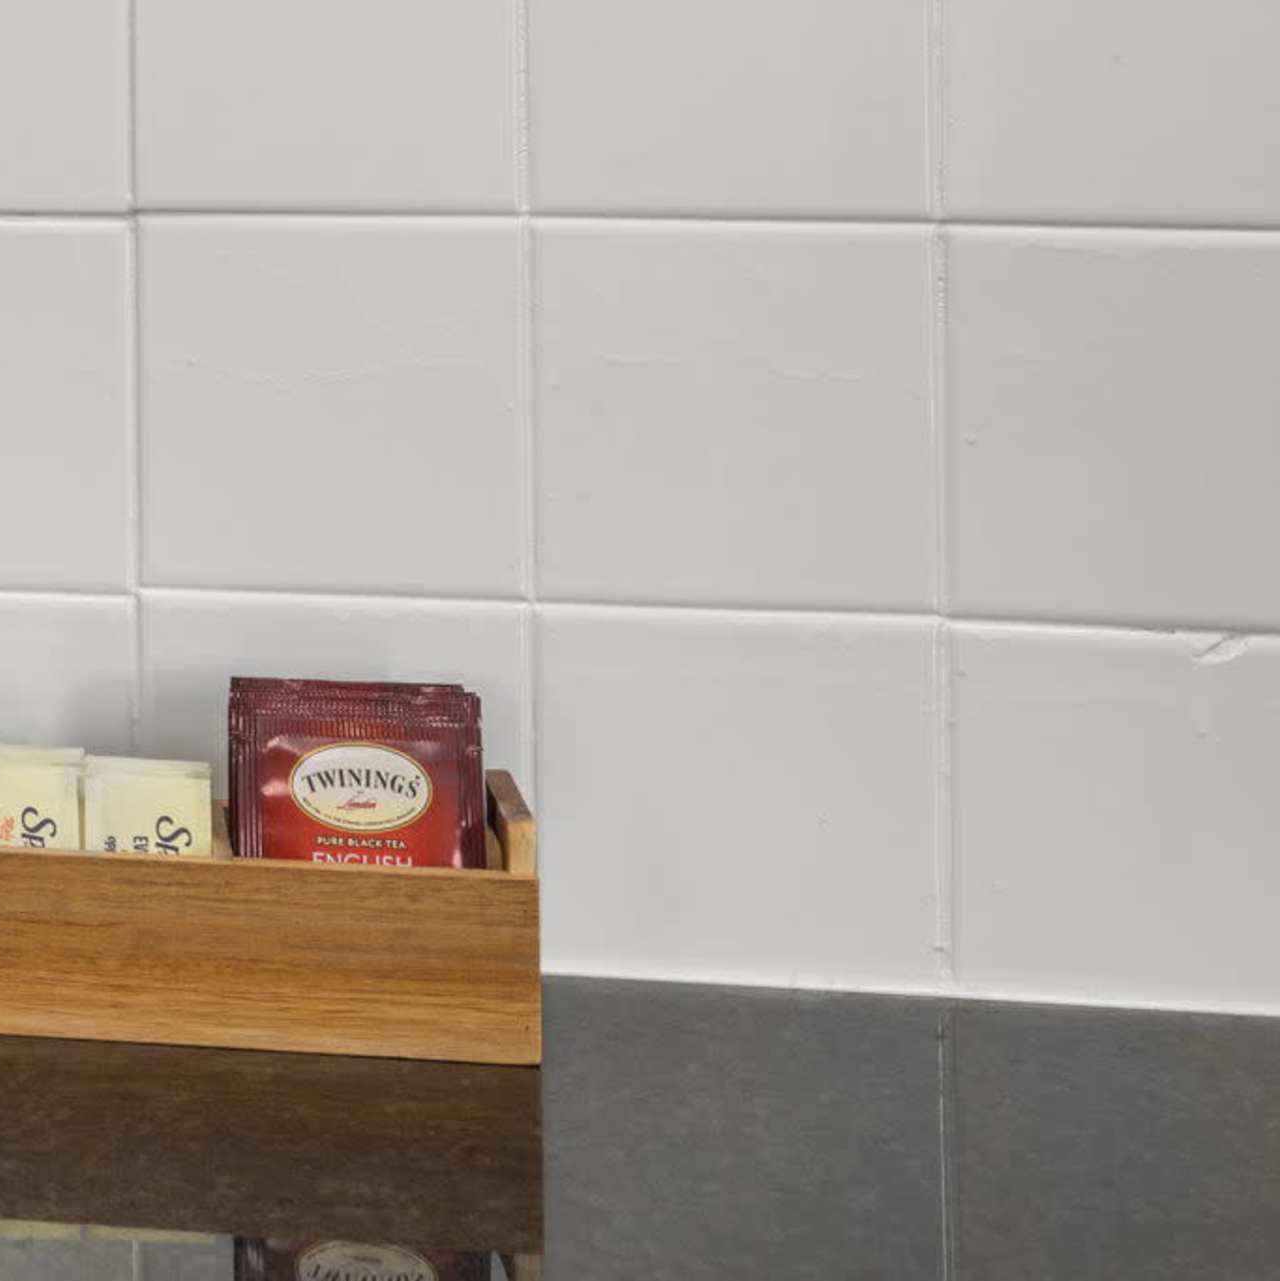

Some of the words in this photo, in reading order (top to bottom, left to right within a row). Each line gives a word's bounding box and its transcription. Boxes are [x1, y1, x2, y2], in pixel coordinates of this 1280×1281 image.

[301, 768, 419, 800] TWININGS
[316, 836, 345, 847] PURE
[347, 837, 383, 849] BLACK
[385, 839, 407, 849] TEA
